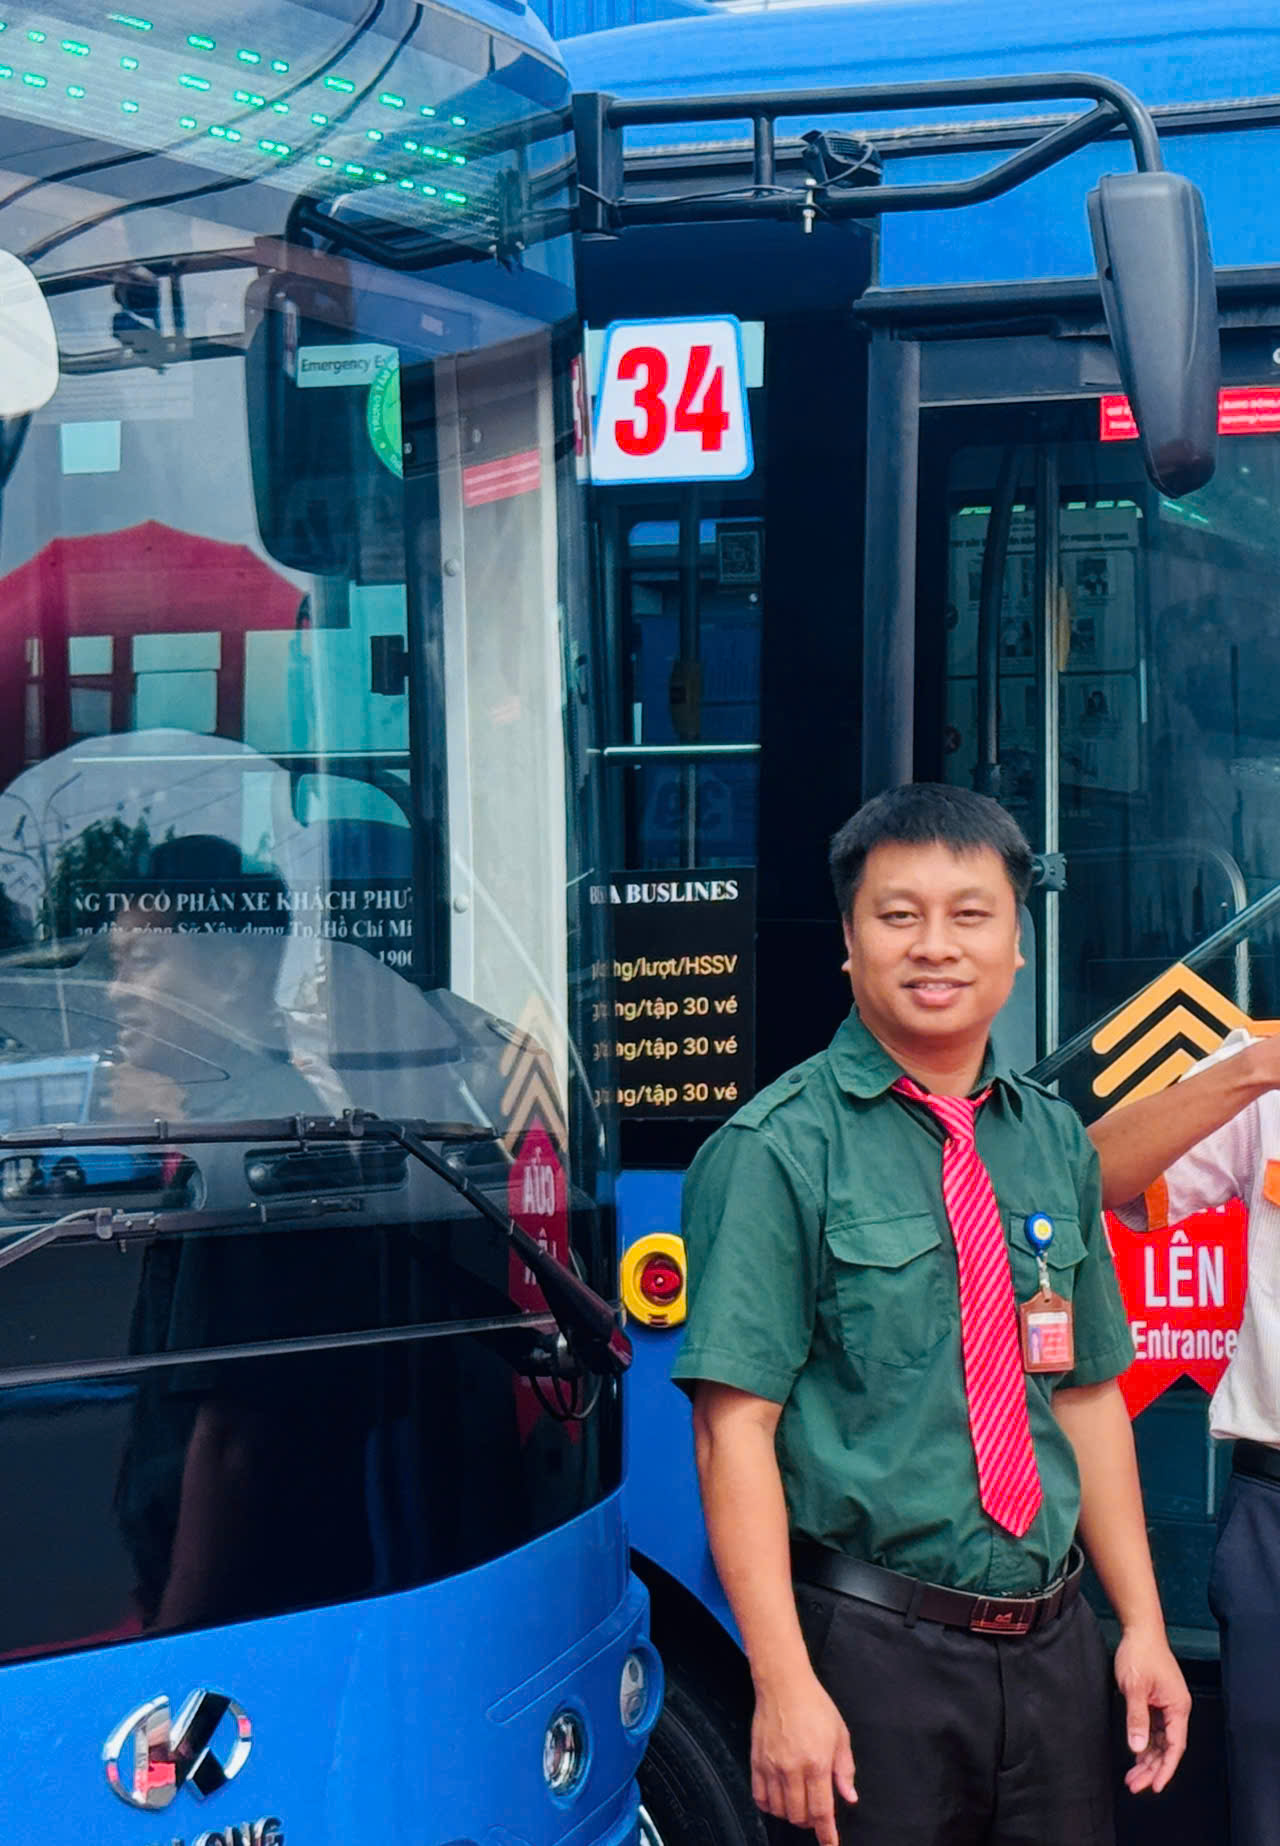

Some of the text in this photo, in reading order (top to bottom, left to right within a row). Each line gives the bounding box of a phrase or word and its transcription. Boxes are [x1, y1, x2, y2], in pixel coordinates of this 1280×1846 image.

[302, 358, 369, 374] Emergency
[614, 344, 730, 457] 34
[106, 893, 135, 912] TY
[241, 892, 270, 911] XE
[277, 886, 357, 911] KHÁCH
[363, 887, 413, 911] PHƯ
[626, 880, 739, 904] BUSLINES
[353, 920, 384, 938] Chí
[683, 996, 709, 1016] 30
[714, 995, 738, 1014] vé
[683, 1037, 709, 1056] 30
[714, 1034, 738, 1054] vé
[682, 1082, 709, 1102] 30
[714, 1081, 738, 1101] vé
[1143, 1229, 1225, 1307] LÊN
[1131, 1320, 1238, 1360] Entrance
